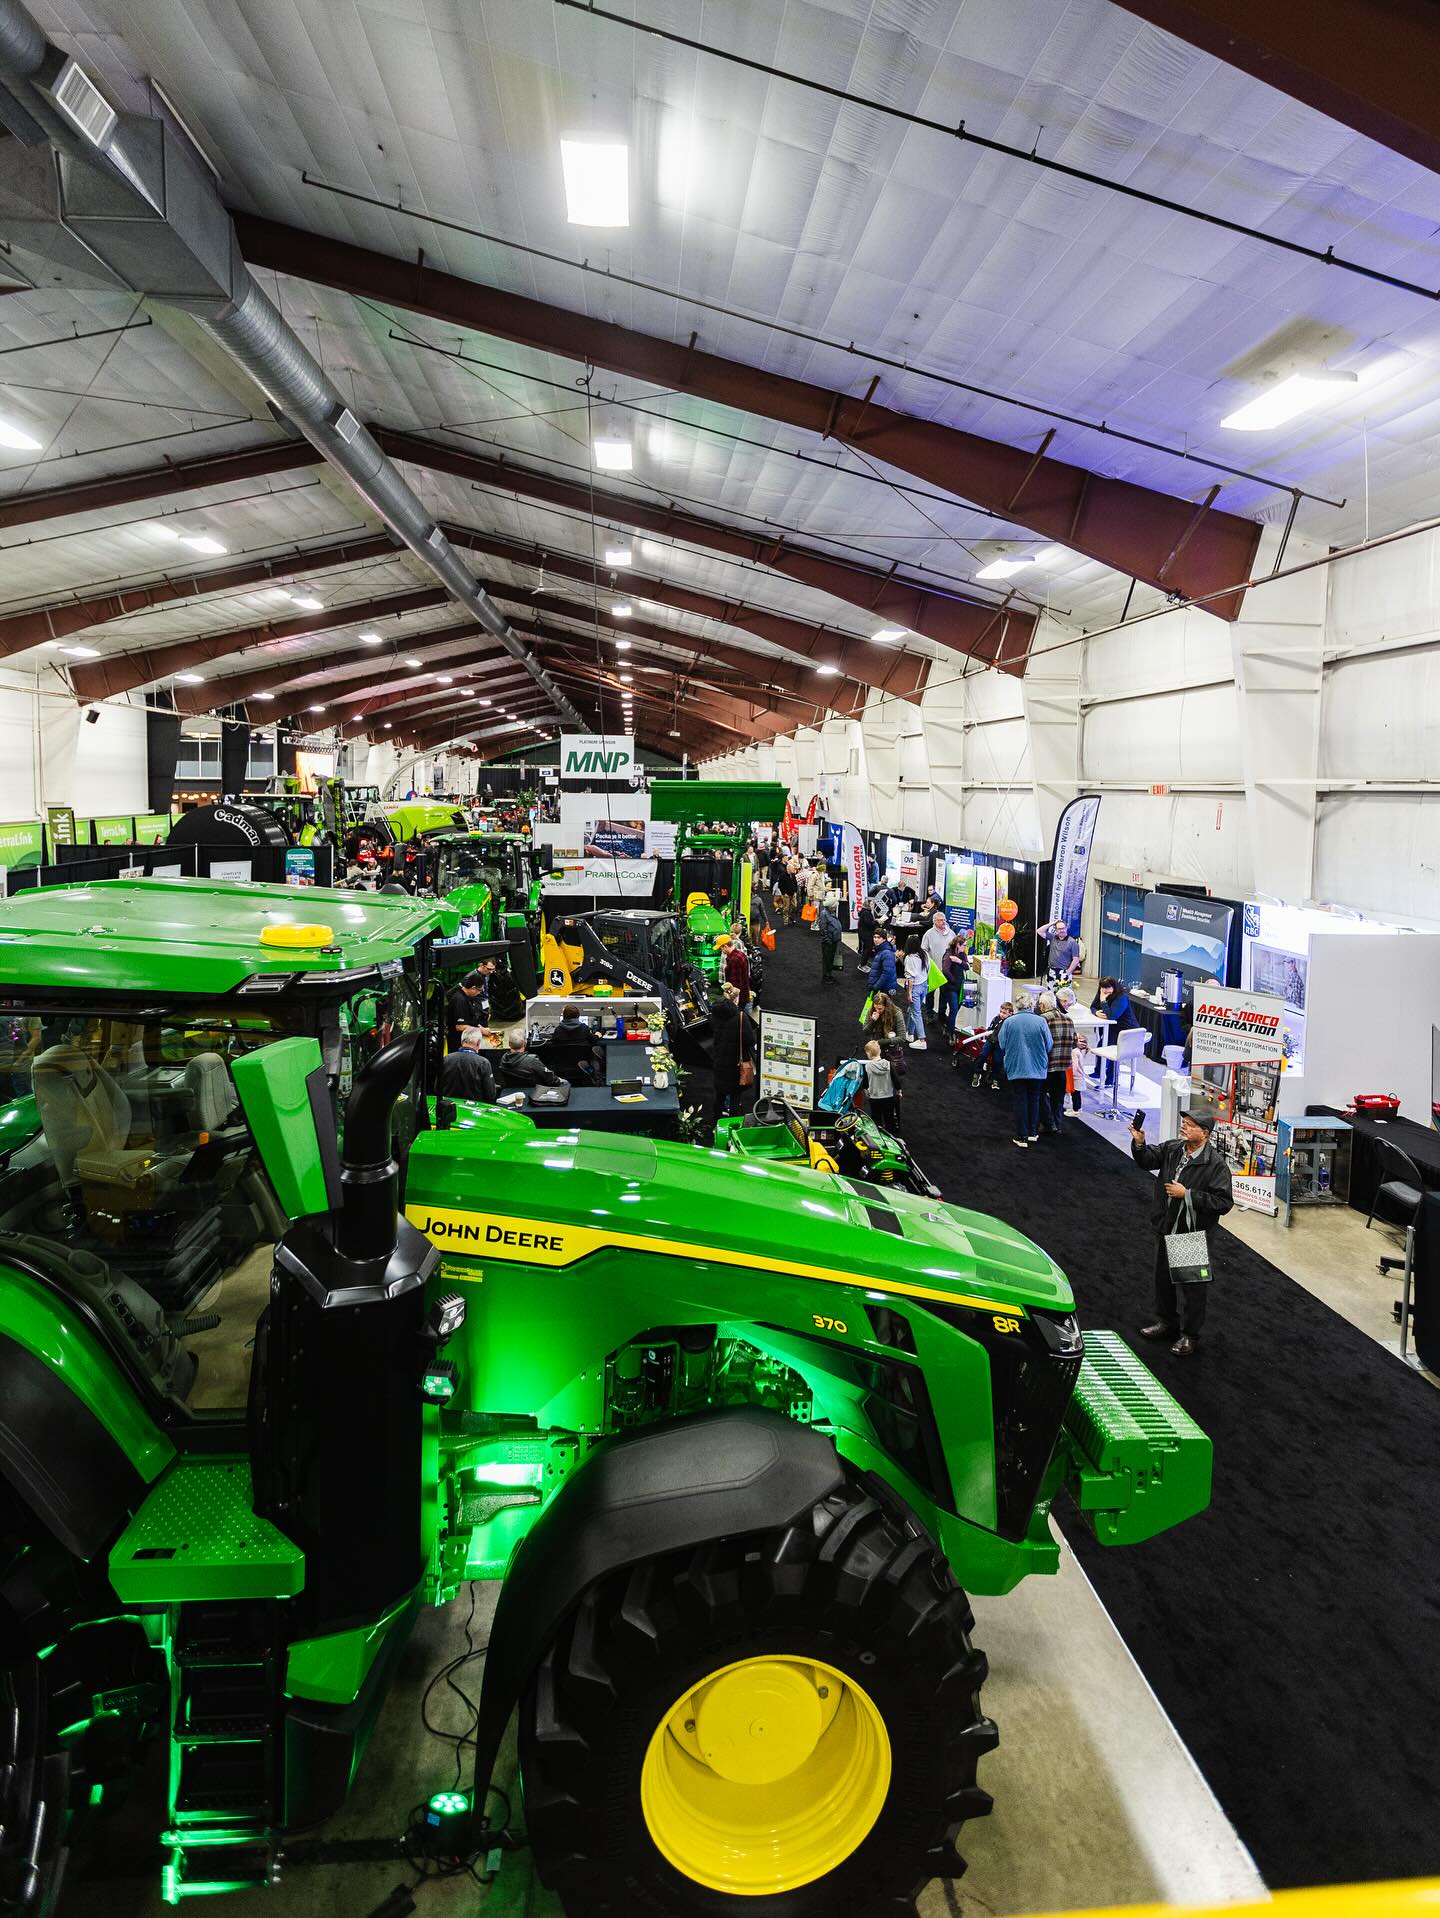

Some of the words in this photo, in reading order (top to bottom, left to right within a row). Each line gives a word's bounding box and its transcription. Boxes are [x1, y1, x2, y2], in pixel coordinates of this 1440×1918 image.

[565, 751, 630, 773] MNP
[1152, 784, 1165, 795] EXIT
[214, 808, 261, 847] Cadman
[1060, 816, 1072, 844] Wilson
[1056, 845, 1067, 880] Cameron
[853, 846, 863, 913] OKANAGAN
[1245, 926, 1259, 936] RBC
[626, 970, 653, 991] DEERE
[1196, 1013, 1277, 1037] INTEGRATION
[1197, 1003, 1280, 1027] APAC-NORCO
[1216, 1042, 1251, 1054] INTEGRATION
[1243, 1041, 1278, 1053] AUTOMATION
[419, 1217, 480, 1241] JOHN
[485, 1225, 564, 1252] DEERE
[812, 1314, 848, 1334] 370
[992, 1316, 1022, 1334] 8R
